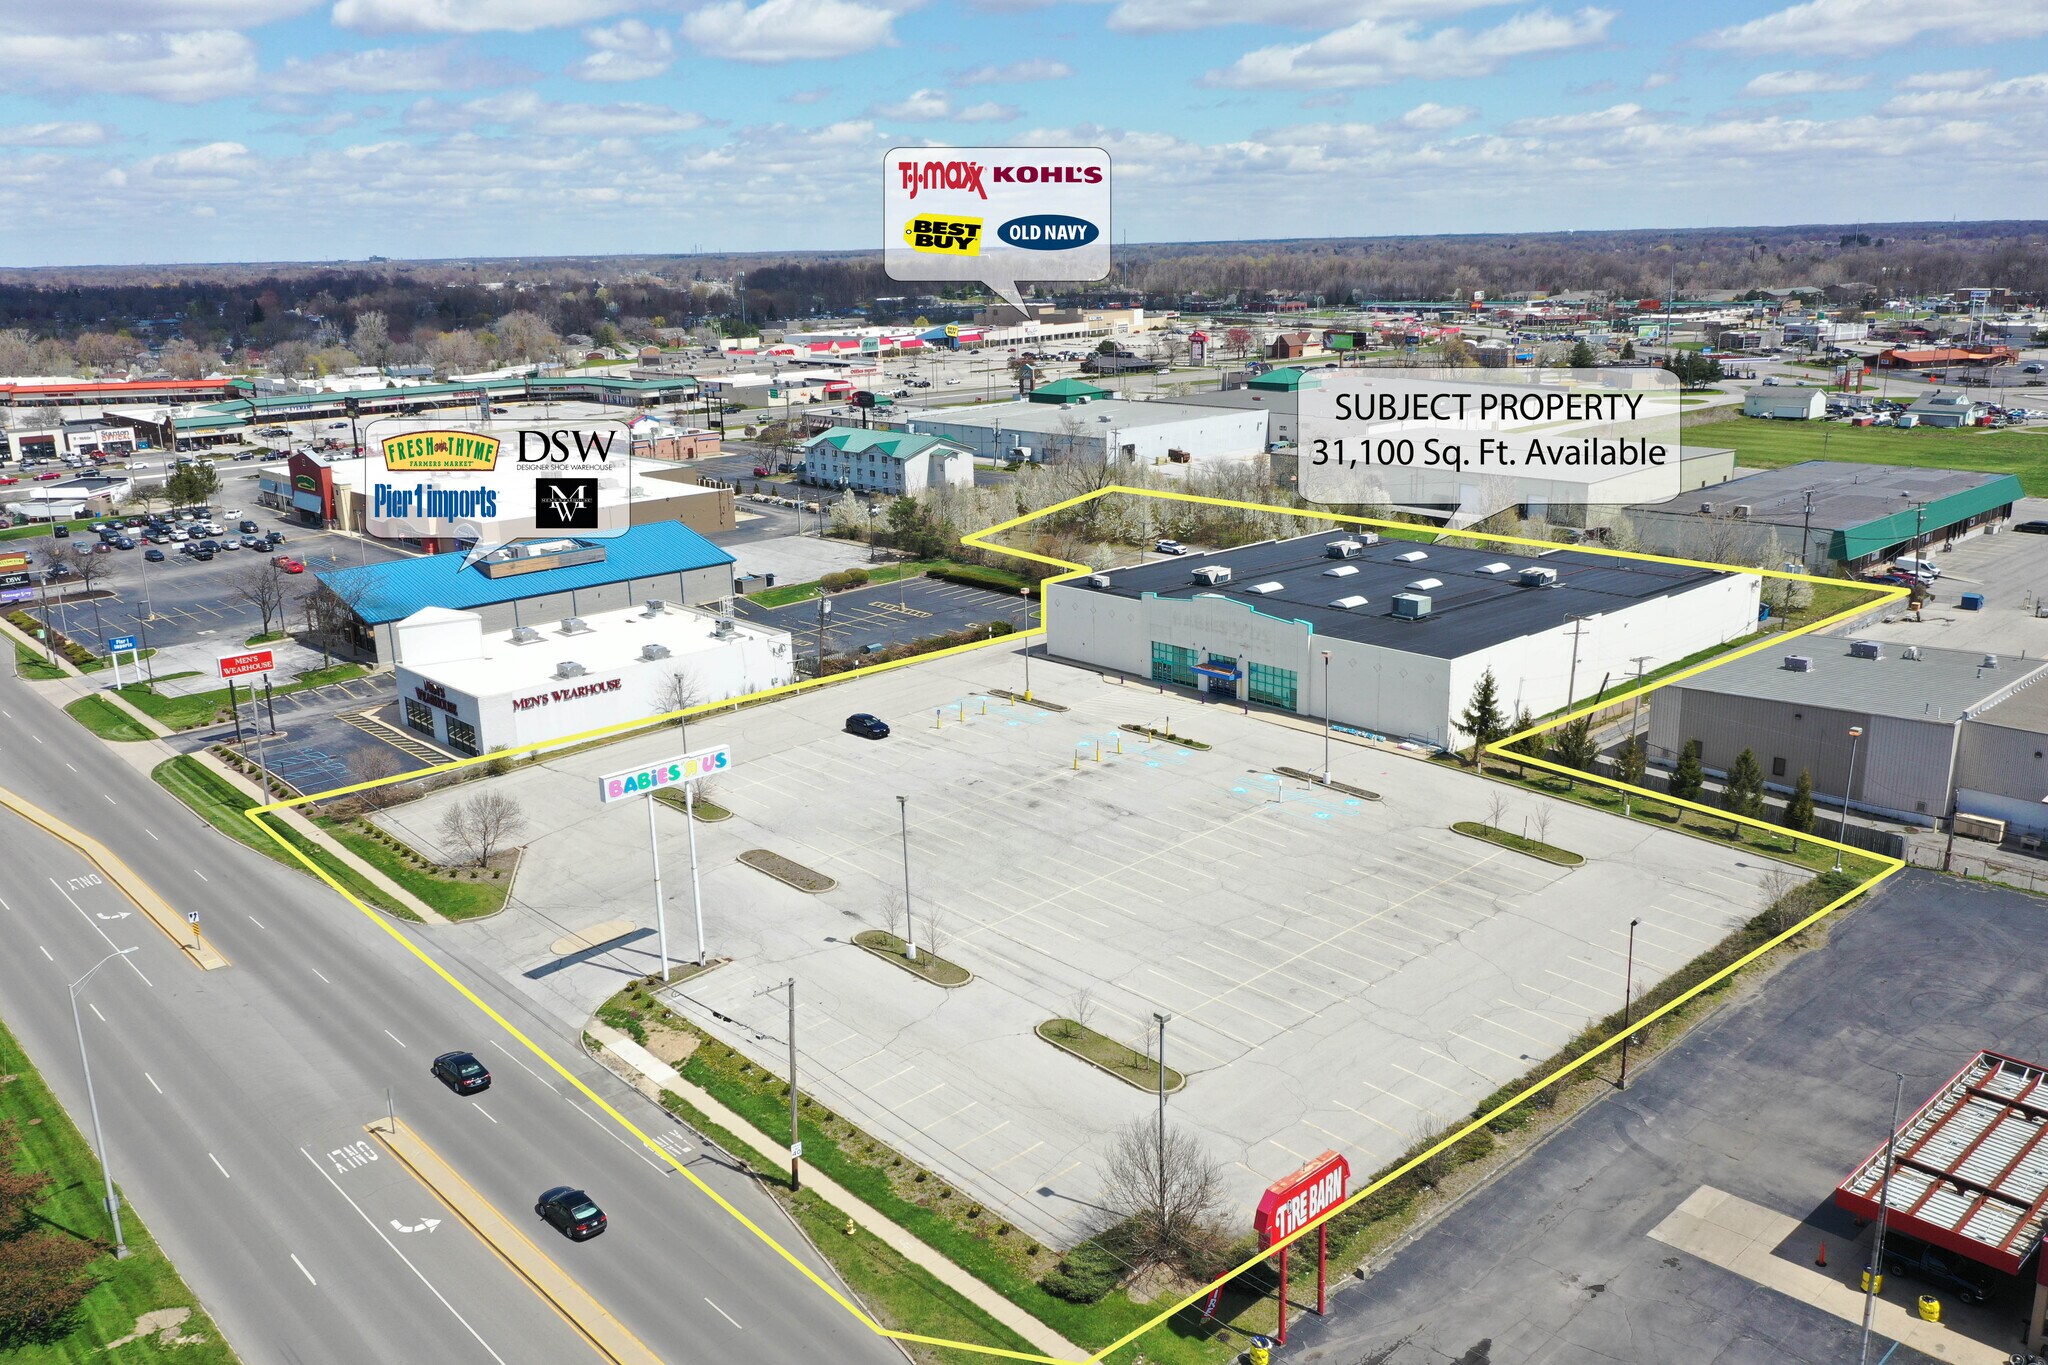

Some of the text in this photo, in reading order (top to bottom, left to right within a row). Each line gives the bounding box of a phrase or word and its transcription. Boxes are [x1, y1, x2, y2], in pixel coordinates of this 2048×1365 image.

[223, 661, 273, 675] WEARHOUSE
[234, 655, 259, 665] MEN'S
[512, 678, 622, 712] MEN'S WEARHOUSE
[702, 752, 727, 772] US
[66, 873, 102, 891] ONLY
[326, 1140, 379, 1174] ONLY
[1309, 1165, 1342, 1219] BARN
